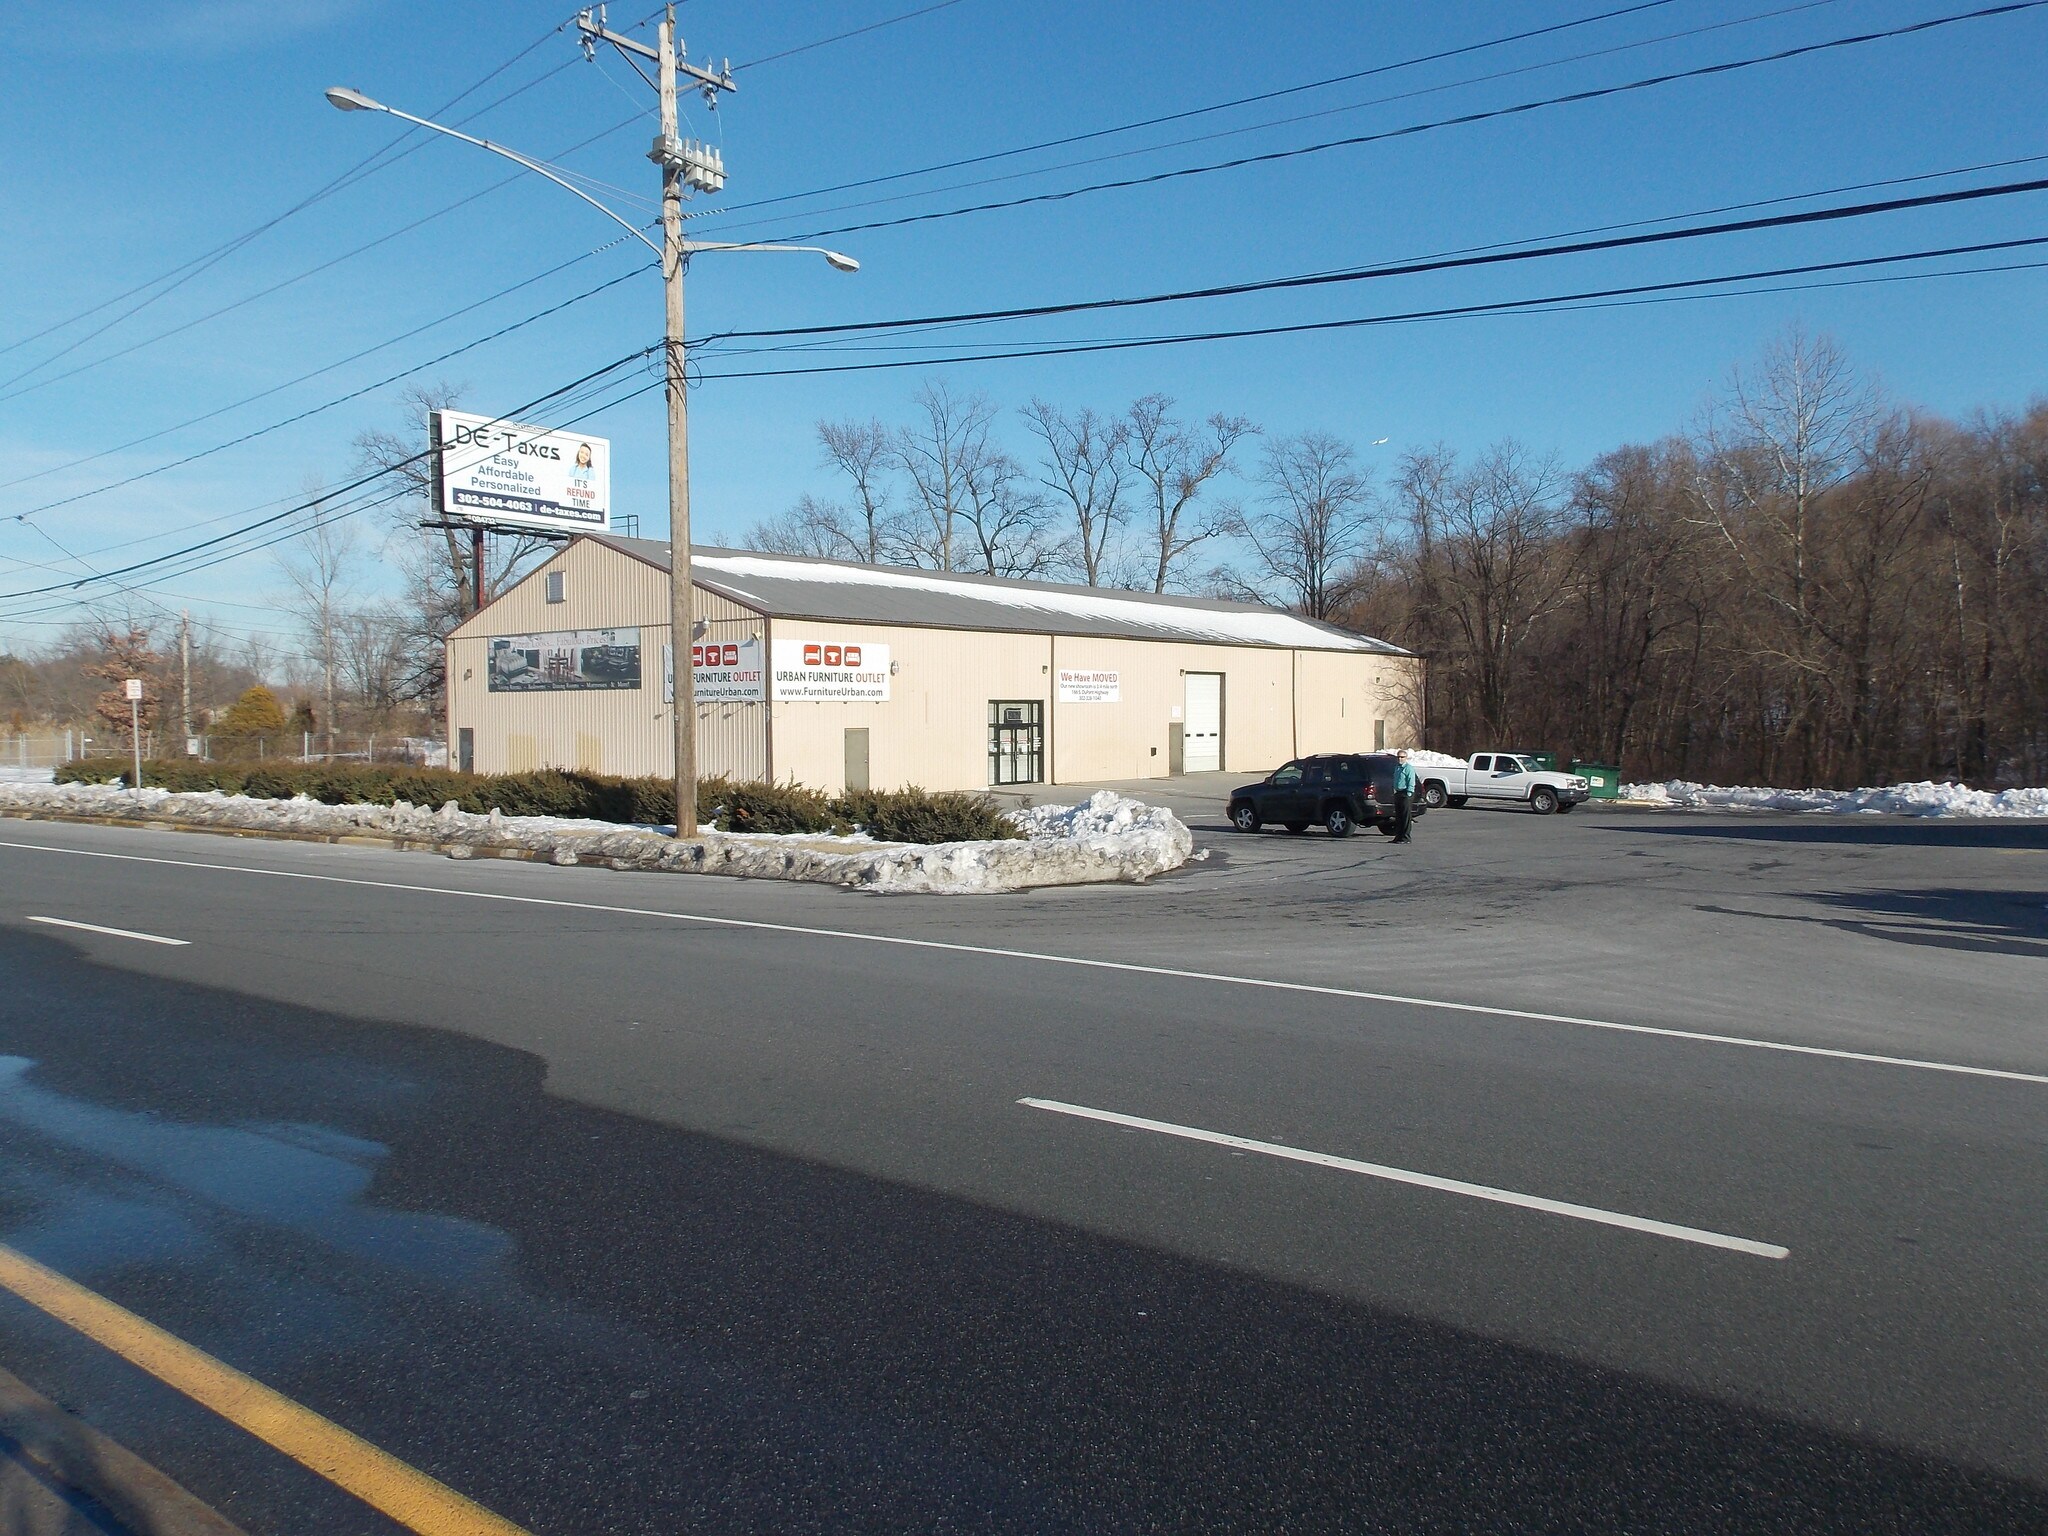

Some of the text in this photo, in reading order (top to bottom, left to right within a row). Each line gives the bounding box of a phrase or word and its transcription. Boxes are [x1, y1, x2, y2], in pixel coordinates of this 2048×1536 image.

[456, 424, 561, 461] DE-Taxes
[493, 454, 519, 467] Easy
[478, 465, 534, 482] Affordable
[471, 477, 541, 496] Personalized
[574, 479, 588, 488] IT'S
[566, 487, 596, 500] REFUND
[457, 493, 601, 521] 302-504-4063 de-taxes.com
[572, 498, 591, 508] TIME
[733, 671, 761, 682] OUTLET
[776, 671, 885, 684] URBAN FURNITURE OUTLET
[1060, 672, 1118, 683] We Have MOVED
[780, 686, 883, 698] www.FurnitureUrban.com
